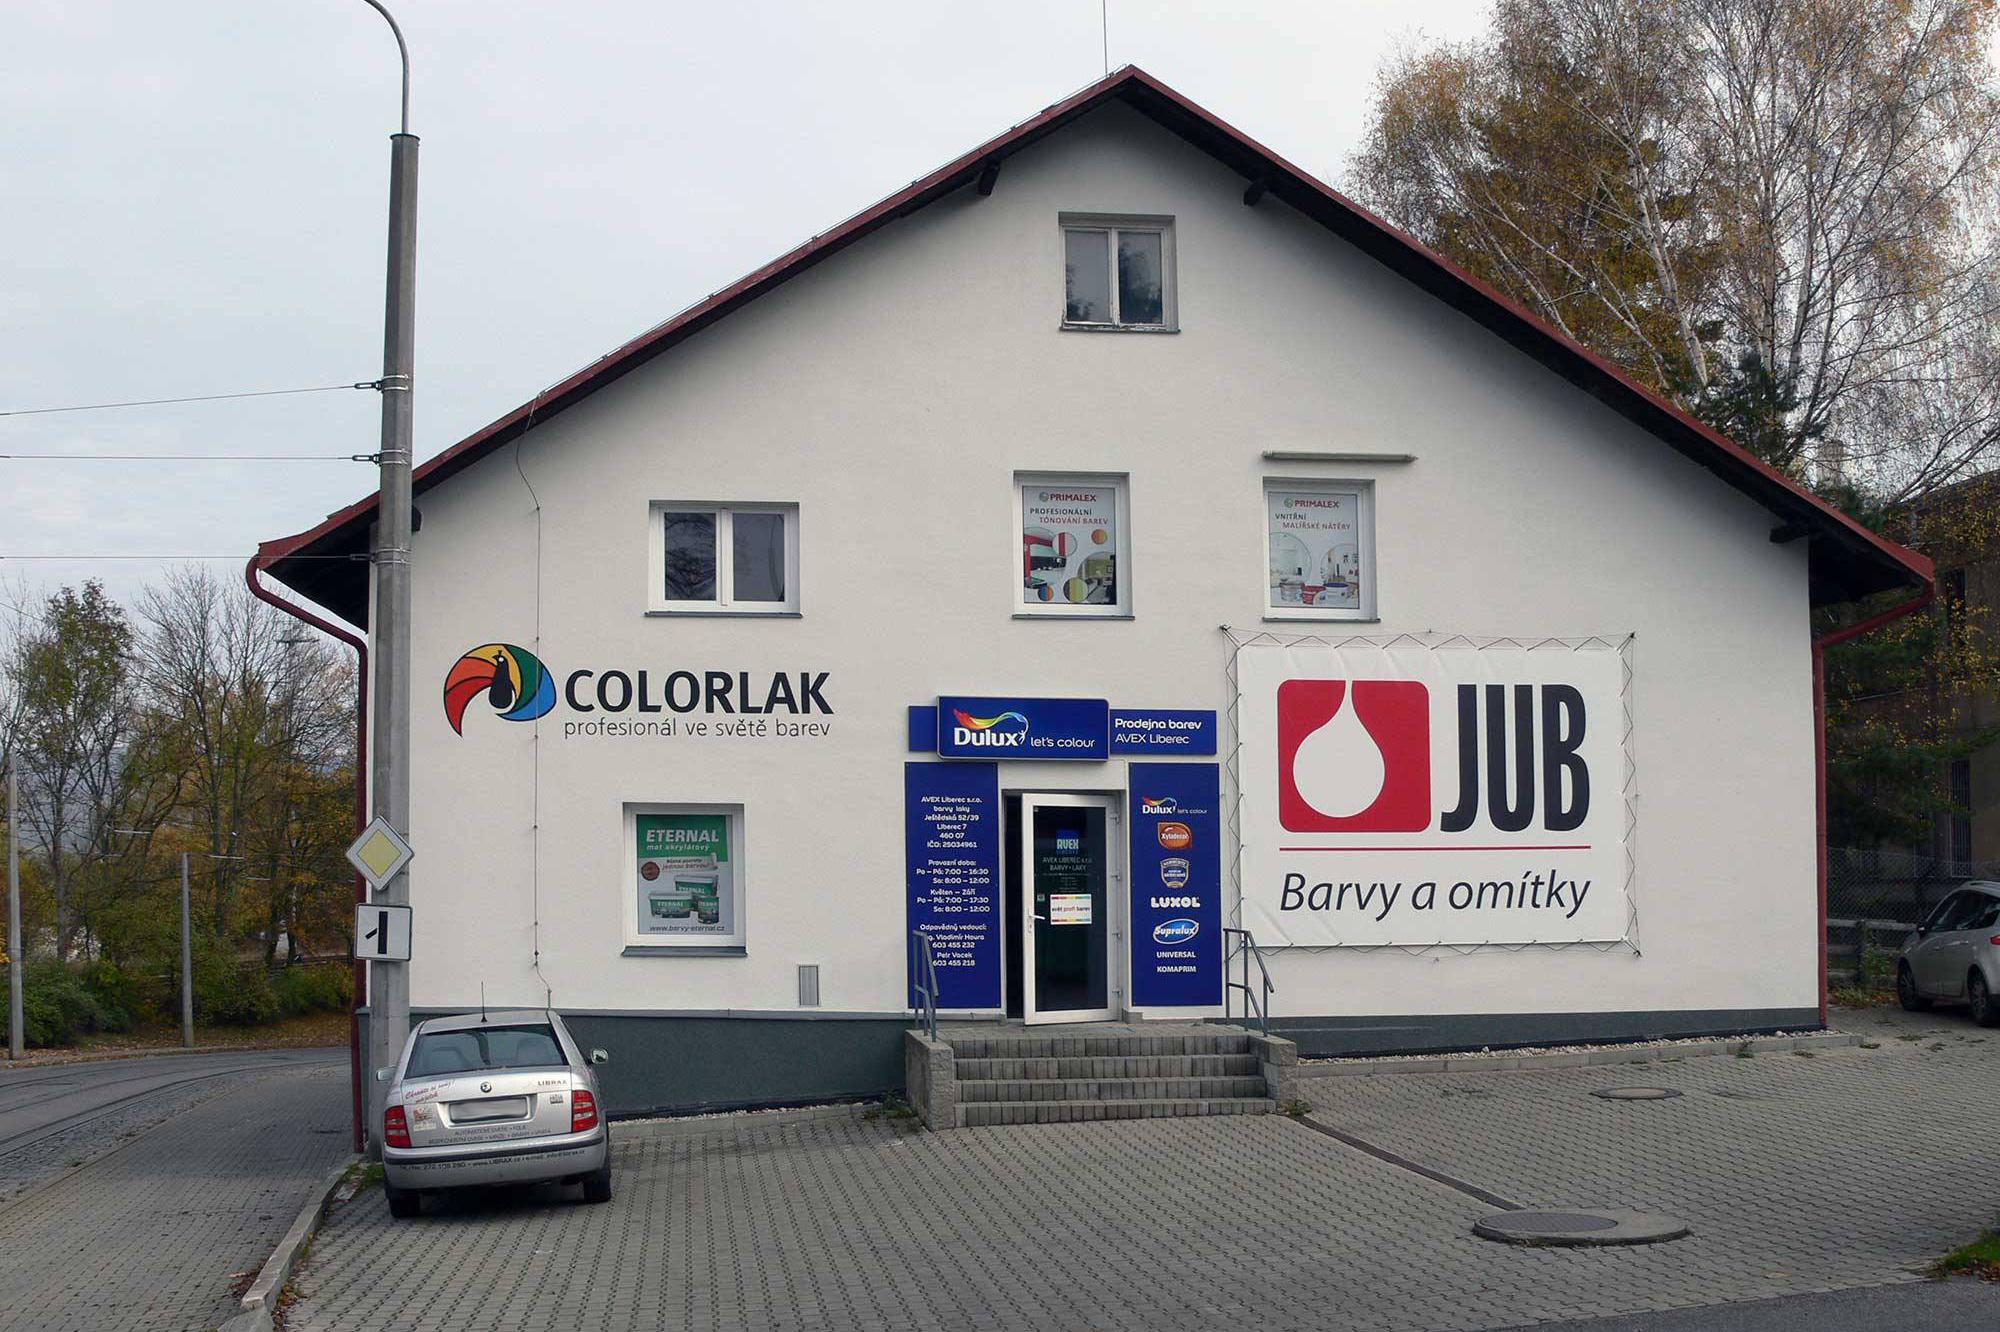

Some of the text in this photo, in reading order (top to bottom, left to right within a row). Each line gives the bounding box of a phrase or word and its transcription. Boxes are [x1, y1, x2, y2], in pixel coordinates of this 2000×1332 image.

[1050, 494, 1096, 502] PRIMALEX
[1295, 500, 1339, 508] PRIMALEX
[565, 670, 834, 715] COLORLAK
[565, 718, 831, 739] profesionál ve světě barev
[1115, 719, 1202, 731] Prodejna barev
[954, 728, 1095, 747] Dulux let's colour
[1115, 734, 1190, 744] AVEX Liberec
[1440, 684, 1590, 832] JUB
[1143, 805, 1172, 814] Dulux
[646, 829, 719, 842] ETERNAL
[1280, 869, 1592, 922] Barvy a omítky
[1151, 897, 1201, 908] LUXOL
[1154, 924, 1196, 937] Supralux
